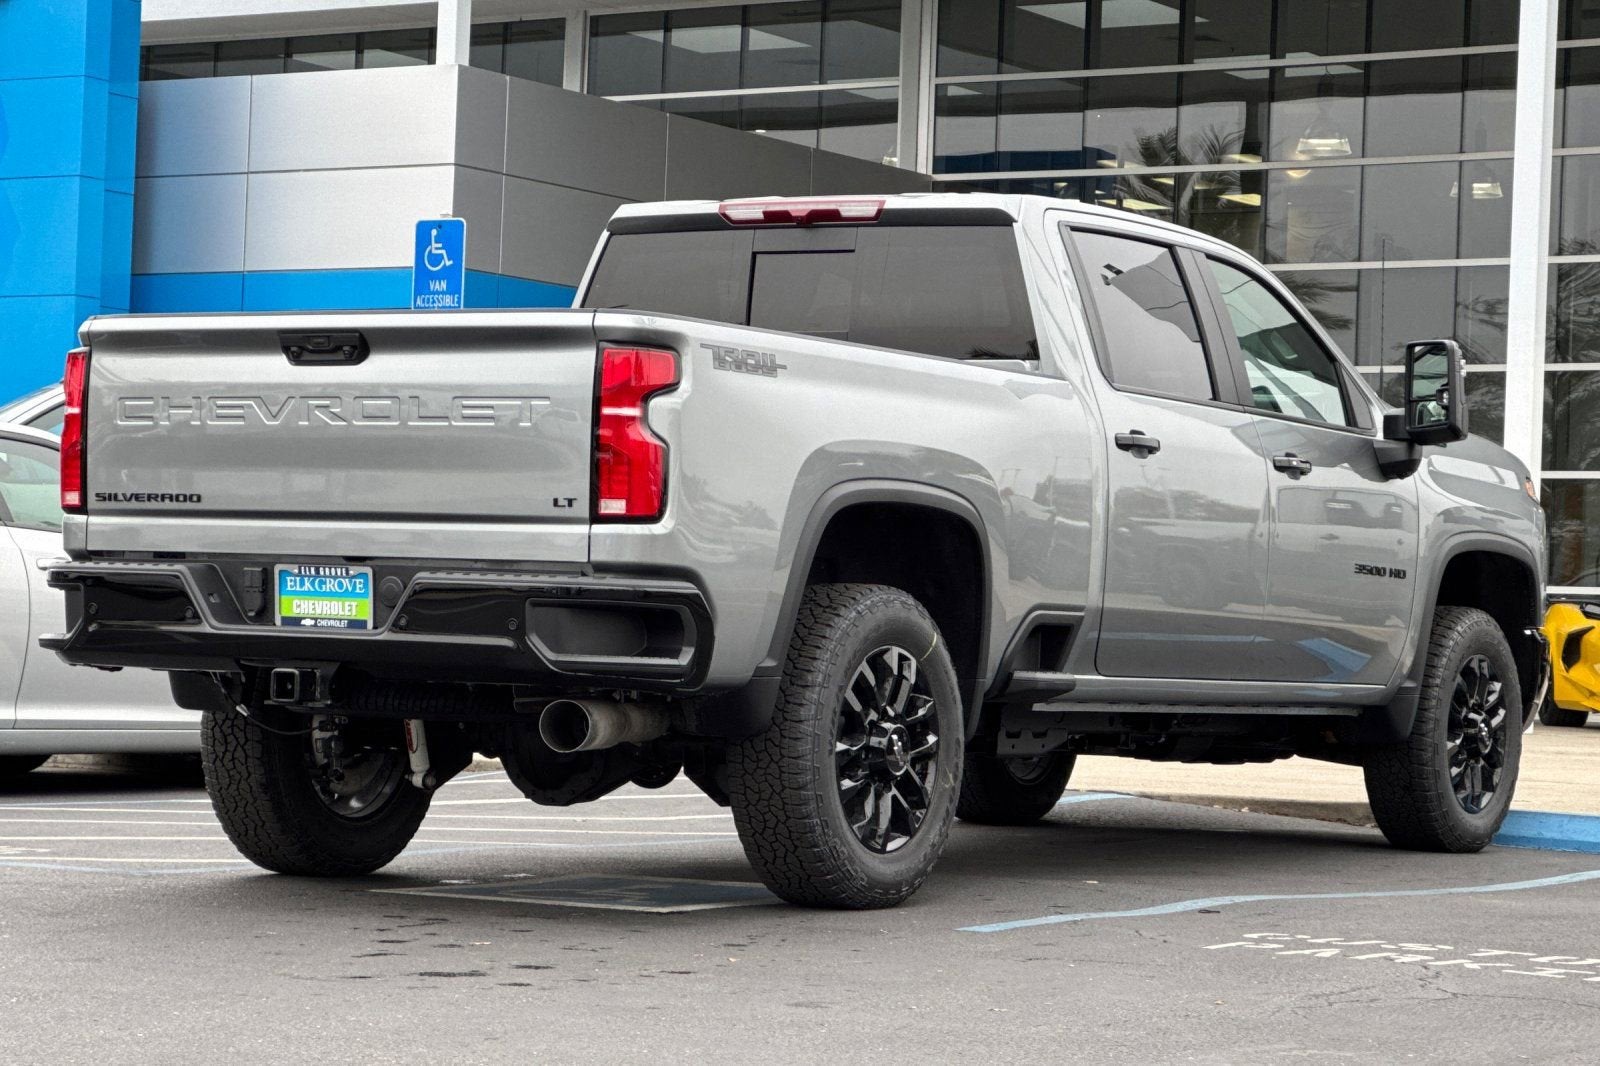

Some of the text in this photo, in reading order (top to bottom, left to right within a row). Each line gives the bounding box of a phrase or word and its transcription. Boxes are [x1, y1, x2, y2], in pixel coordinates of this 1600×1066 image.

[429, 279, 447, 292] VAN
[415, 294, 459, 308] ACCESSIBLE
[115, 396, 551, 426] CHEVROLET
[95, 492, 202, 503] SILVERADO
[552, 497, 577, 508] LT
[300, 566, 347, 576] ELK GROVE
[1354, 563, 1406, 580] 3500 HD
[286, 576, 365, 593] ELK GROVE
[292, 599, 357, 616] CHEVROLET
[316, 619, 348, 628] CHEVROLET
[1242, 932, 1600, 967] CUSTO
[1201, 941, 1600, 982] PARKI
